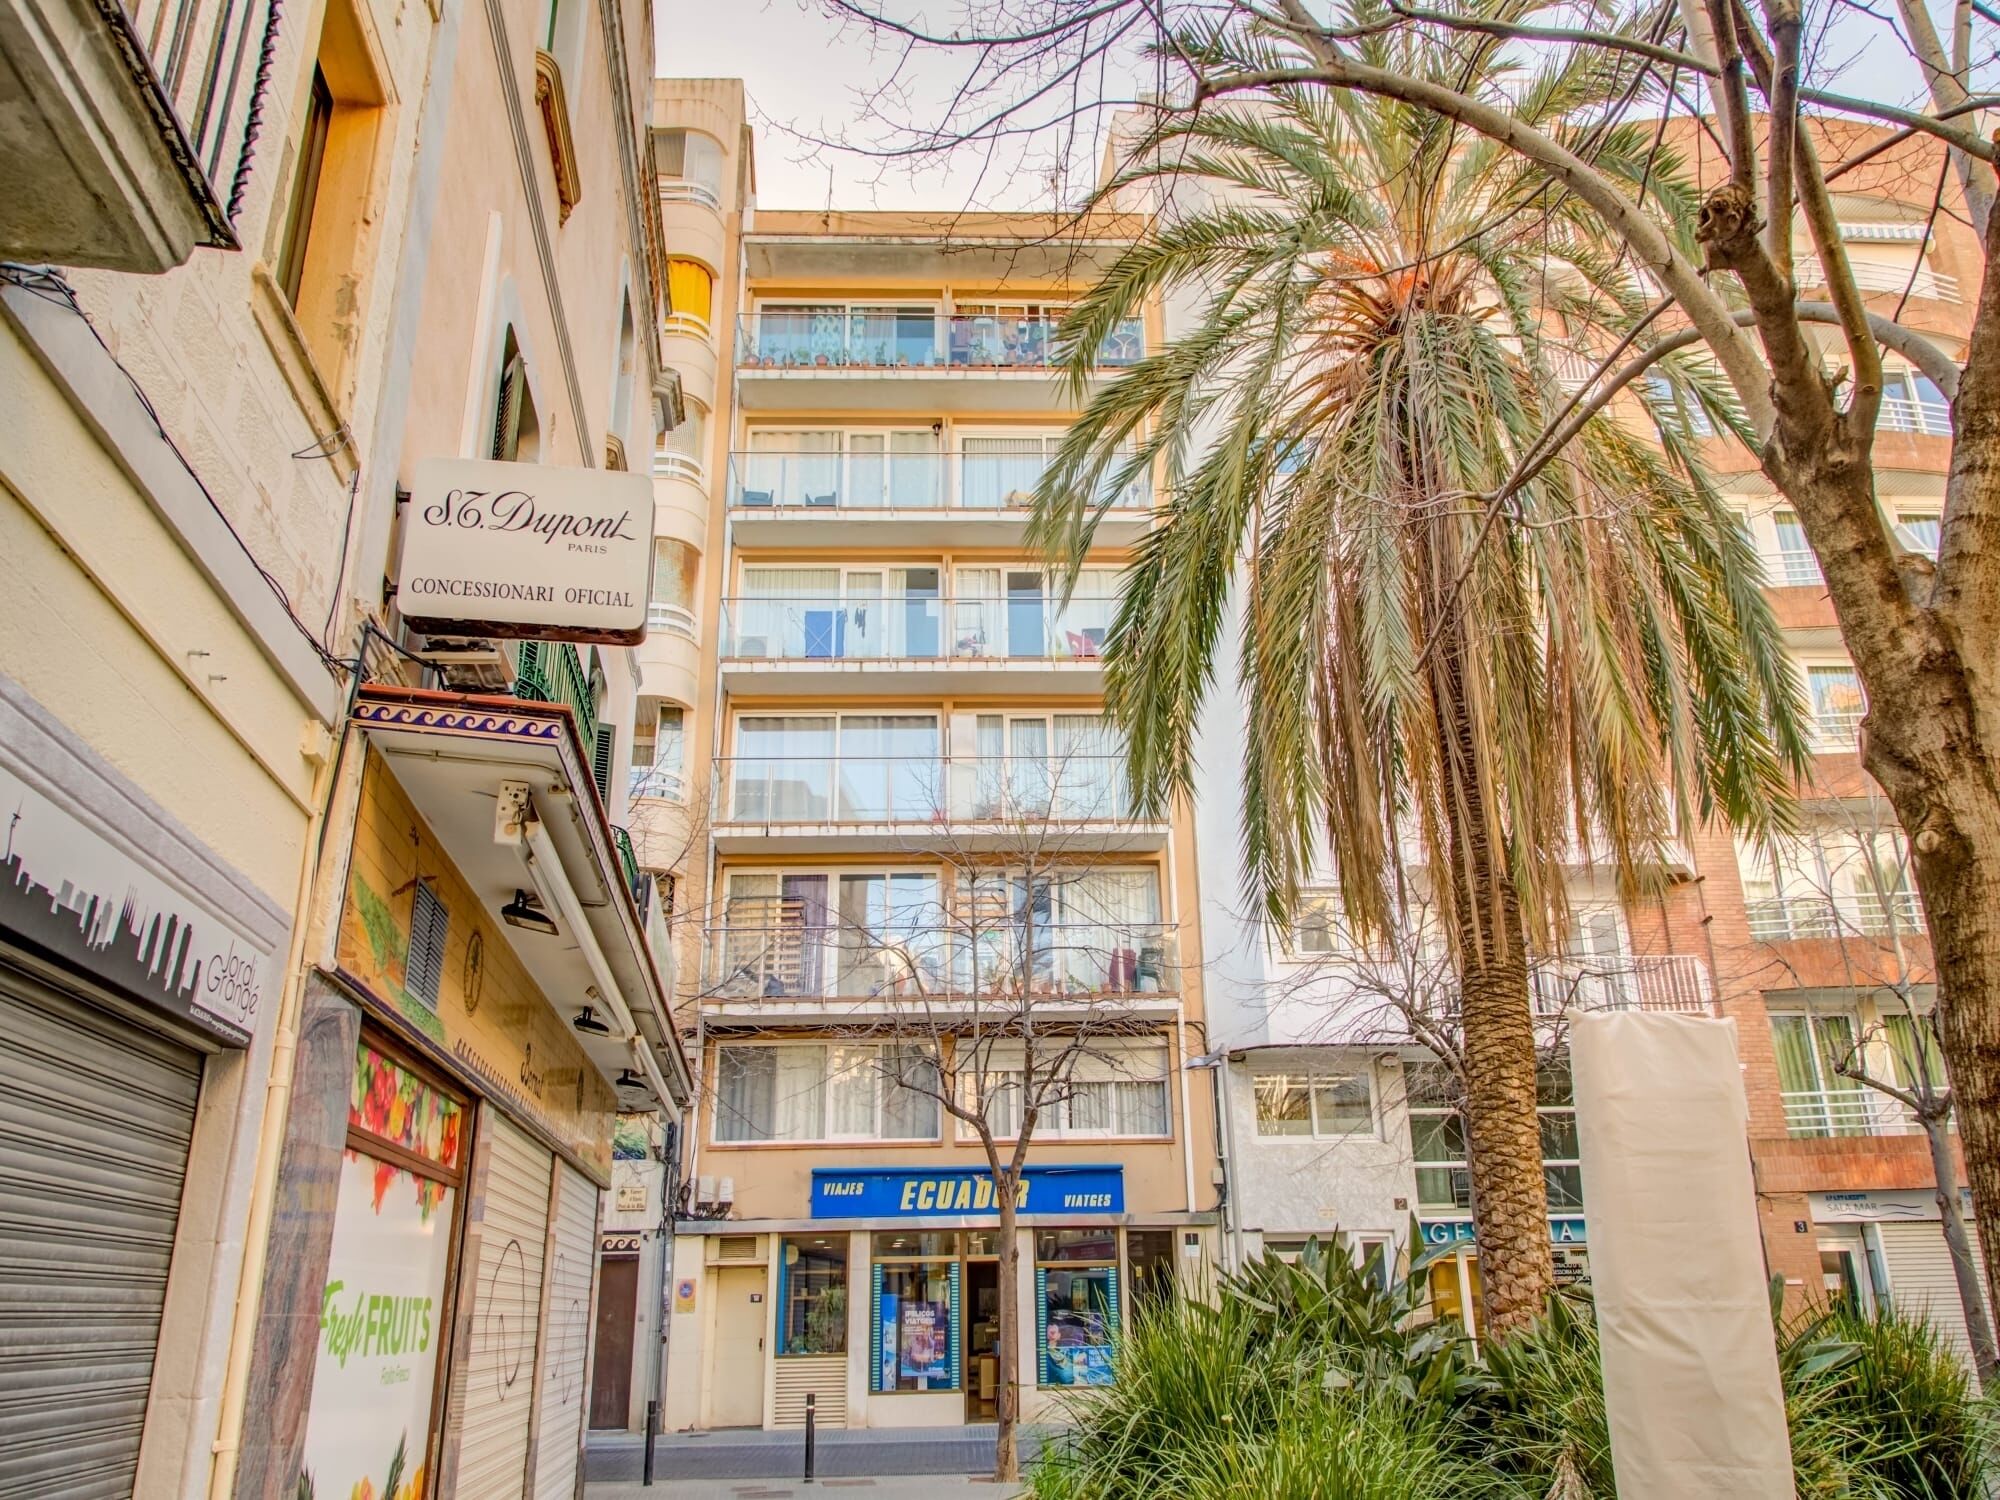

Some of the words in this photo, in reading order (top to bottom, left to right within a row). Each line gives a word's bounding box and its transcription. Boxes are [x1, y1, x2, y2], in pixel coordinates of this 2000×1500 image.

[488, 491, 636, 545] Dupont
[567, 543, 608, 555] PARIS
[411, 577, 554, 602] CONCESSIONARI
[564, 587, 634, 608] OFICIAL
[221, 938, 257, 988] Jordi
[206, 954, 259, 1023] Grangé
[822, 1182, 865, 1196] VIAJES
[1063, 1193, 1112, 1208] VIATGES
[1853, 1202, 1878, 1211] MAR
[320, 1280, 364, 1370] Fresh
[363, 1295, 432, 1358] FRUITS
